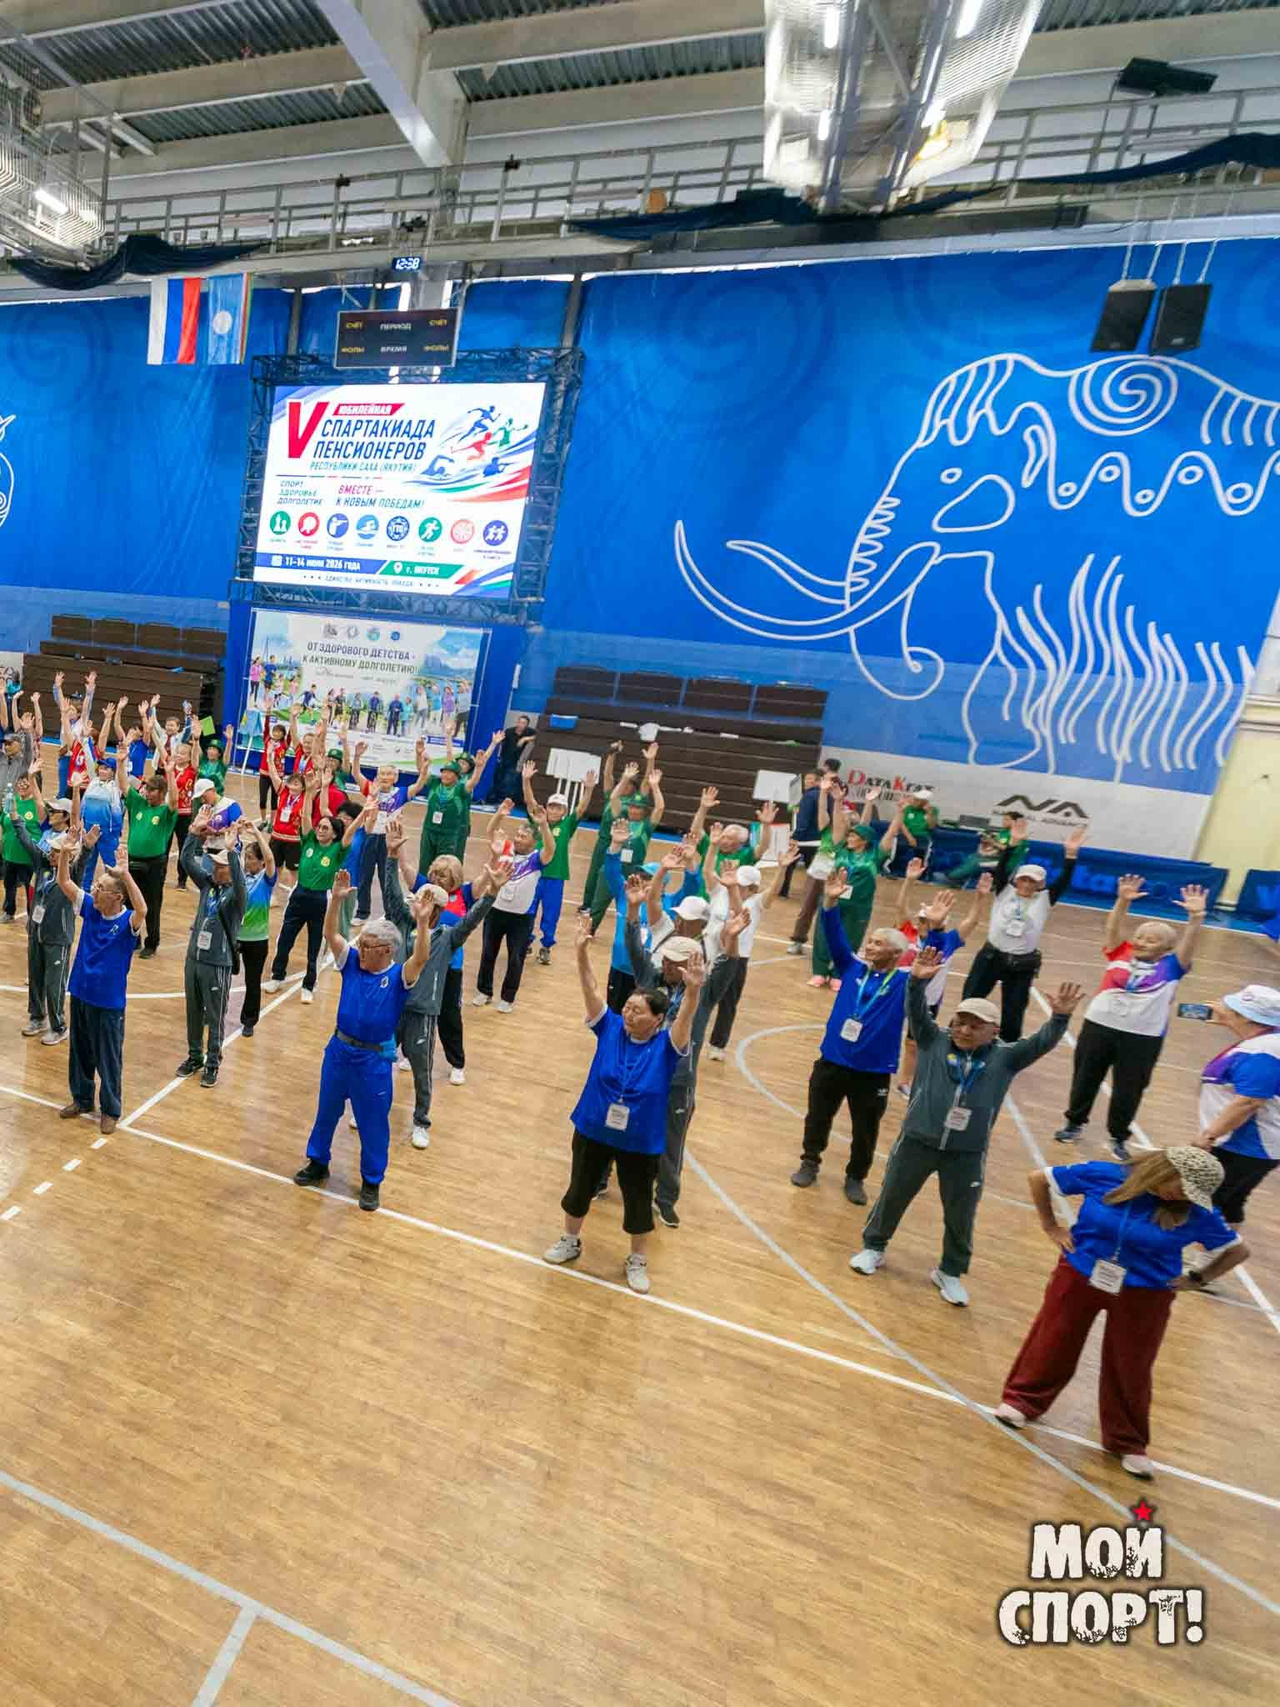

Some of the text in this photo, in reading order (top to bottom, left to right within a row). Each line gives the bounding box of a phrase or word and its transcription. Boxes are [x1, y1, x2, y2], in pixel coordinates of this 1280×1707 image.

[380, 323, 411, 331] ПЕРИОД
[338, 404, 392, 415] ЮБИЛЕЙНАЯ
[288, 401, 330, 459] V
[321, 419, 436, 441] СПАРТАКИАДА
[313, 441, 427, 461] ПЕНСИОНЕРОВ
[310, 462, 417, 472] РЕСПУБЛИКИ САХА (ЯКУТИЯ)
[279, 489, 317, 497] ЗДОРОВЬЕ
[338, 485, 374, 495] ВМЕСТЕ
[276, 497, 323, 506] ДОЛГОЛЕТИЕ
[344, 498, 377, 508] НОВЫМ
[379, 498, 425, 510] ПОБЕДАМ!
[307, 641, 317, 651] ОТ
[319, 642, 369, 657] ЗДОРОВОГО
[370, 648, 410, 661] ДЕТСТВА
[302, 654, 308, 662] К
[309, 655, 357, 668] АКТИВНОМУ
[358, 660, 418, 674] ДОЛГОЛЕТИЮ!
